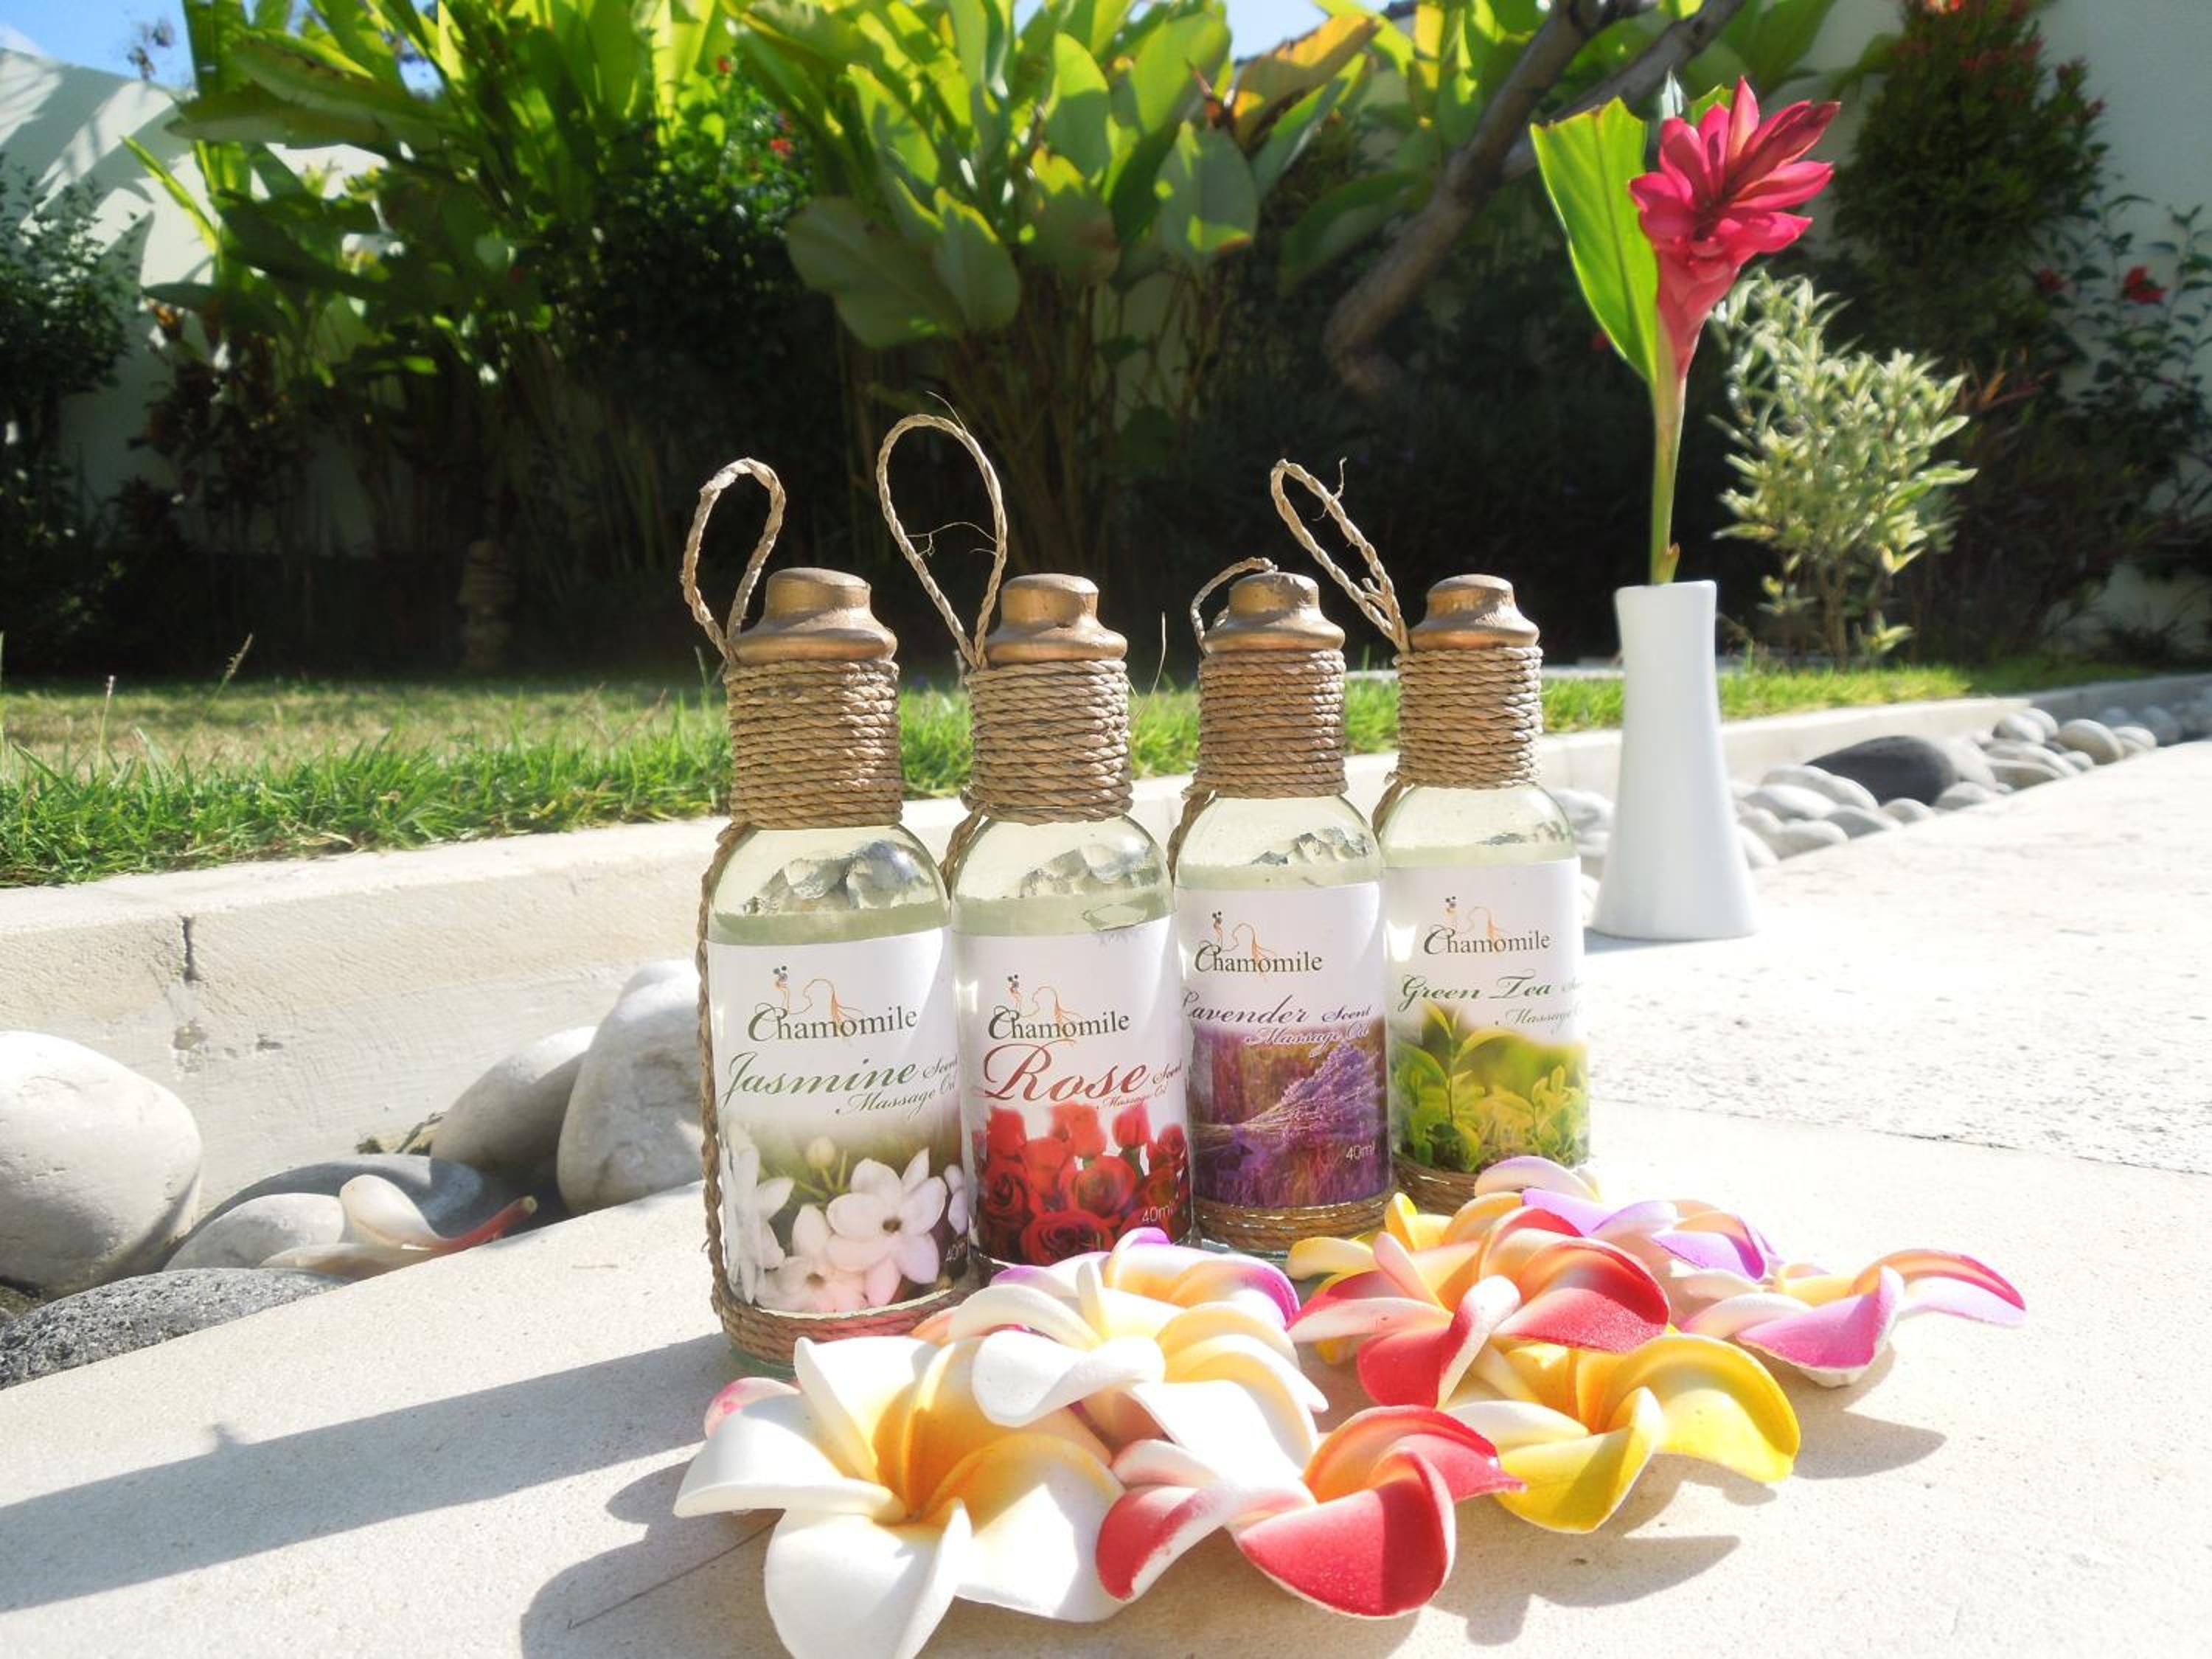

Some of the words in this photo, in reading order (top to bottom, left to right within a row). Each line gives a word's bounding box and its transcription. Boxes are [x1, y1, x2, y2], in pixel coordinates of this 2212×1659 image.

[1194, 939, 1323, 973] Chamomile
[1424, 924, 1551, 955] Chamomile
[1397, 974, 1481, 1012] Green
[1488, 968, 1552, 1000] Tea
[748, 1002, 918, 1042] Chamomile
[987, 1005, 1131, 1041] Chamomile
[1182, 991, 1310, 1025] Lavender
[1321, 1004, 1372, 1023] Scent
[1246, 1026, 1344, 1059] Massage
[720, 1051, 919, 1110] Jasmine
[983, 1039, 1150, 1102] Rose
[835, 1090, 935, 1121] Massage
[1346, 1139, 1376, 1161] 40ml
